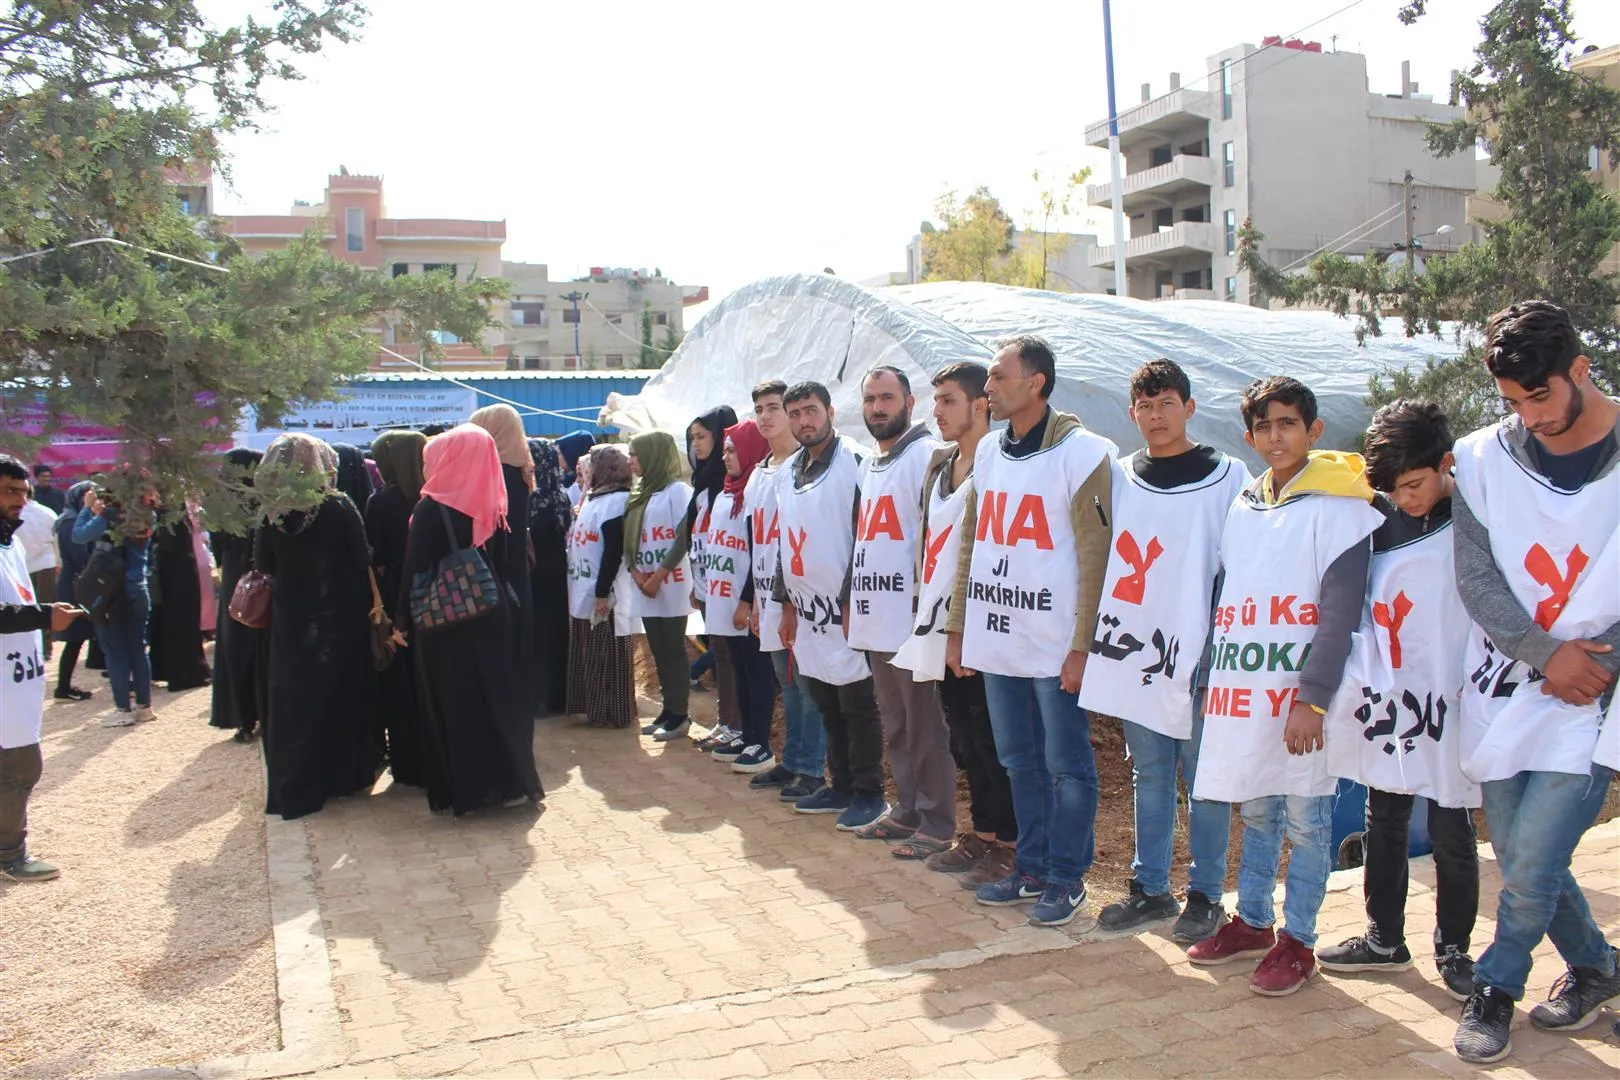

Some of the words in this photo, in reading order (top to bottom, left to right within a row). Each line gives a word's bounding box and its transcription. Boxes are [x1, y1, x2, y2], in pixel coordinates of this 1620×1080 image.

[857, 494, 905, 542] NA
[976, 490, 1054, 550] NA
[1112, 529, 1165, 606] لا
[1524, 542, 1590, 633] لا
[986, 613, 1010, 634] RE
[1241, 596, 1256, 626] û
[1269, 595, 1320, 626] Ka
